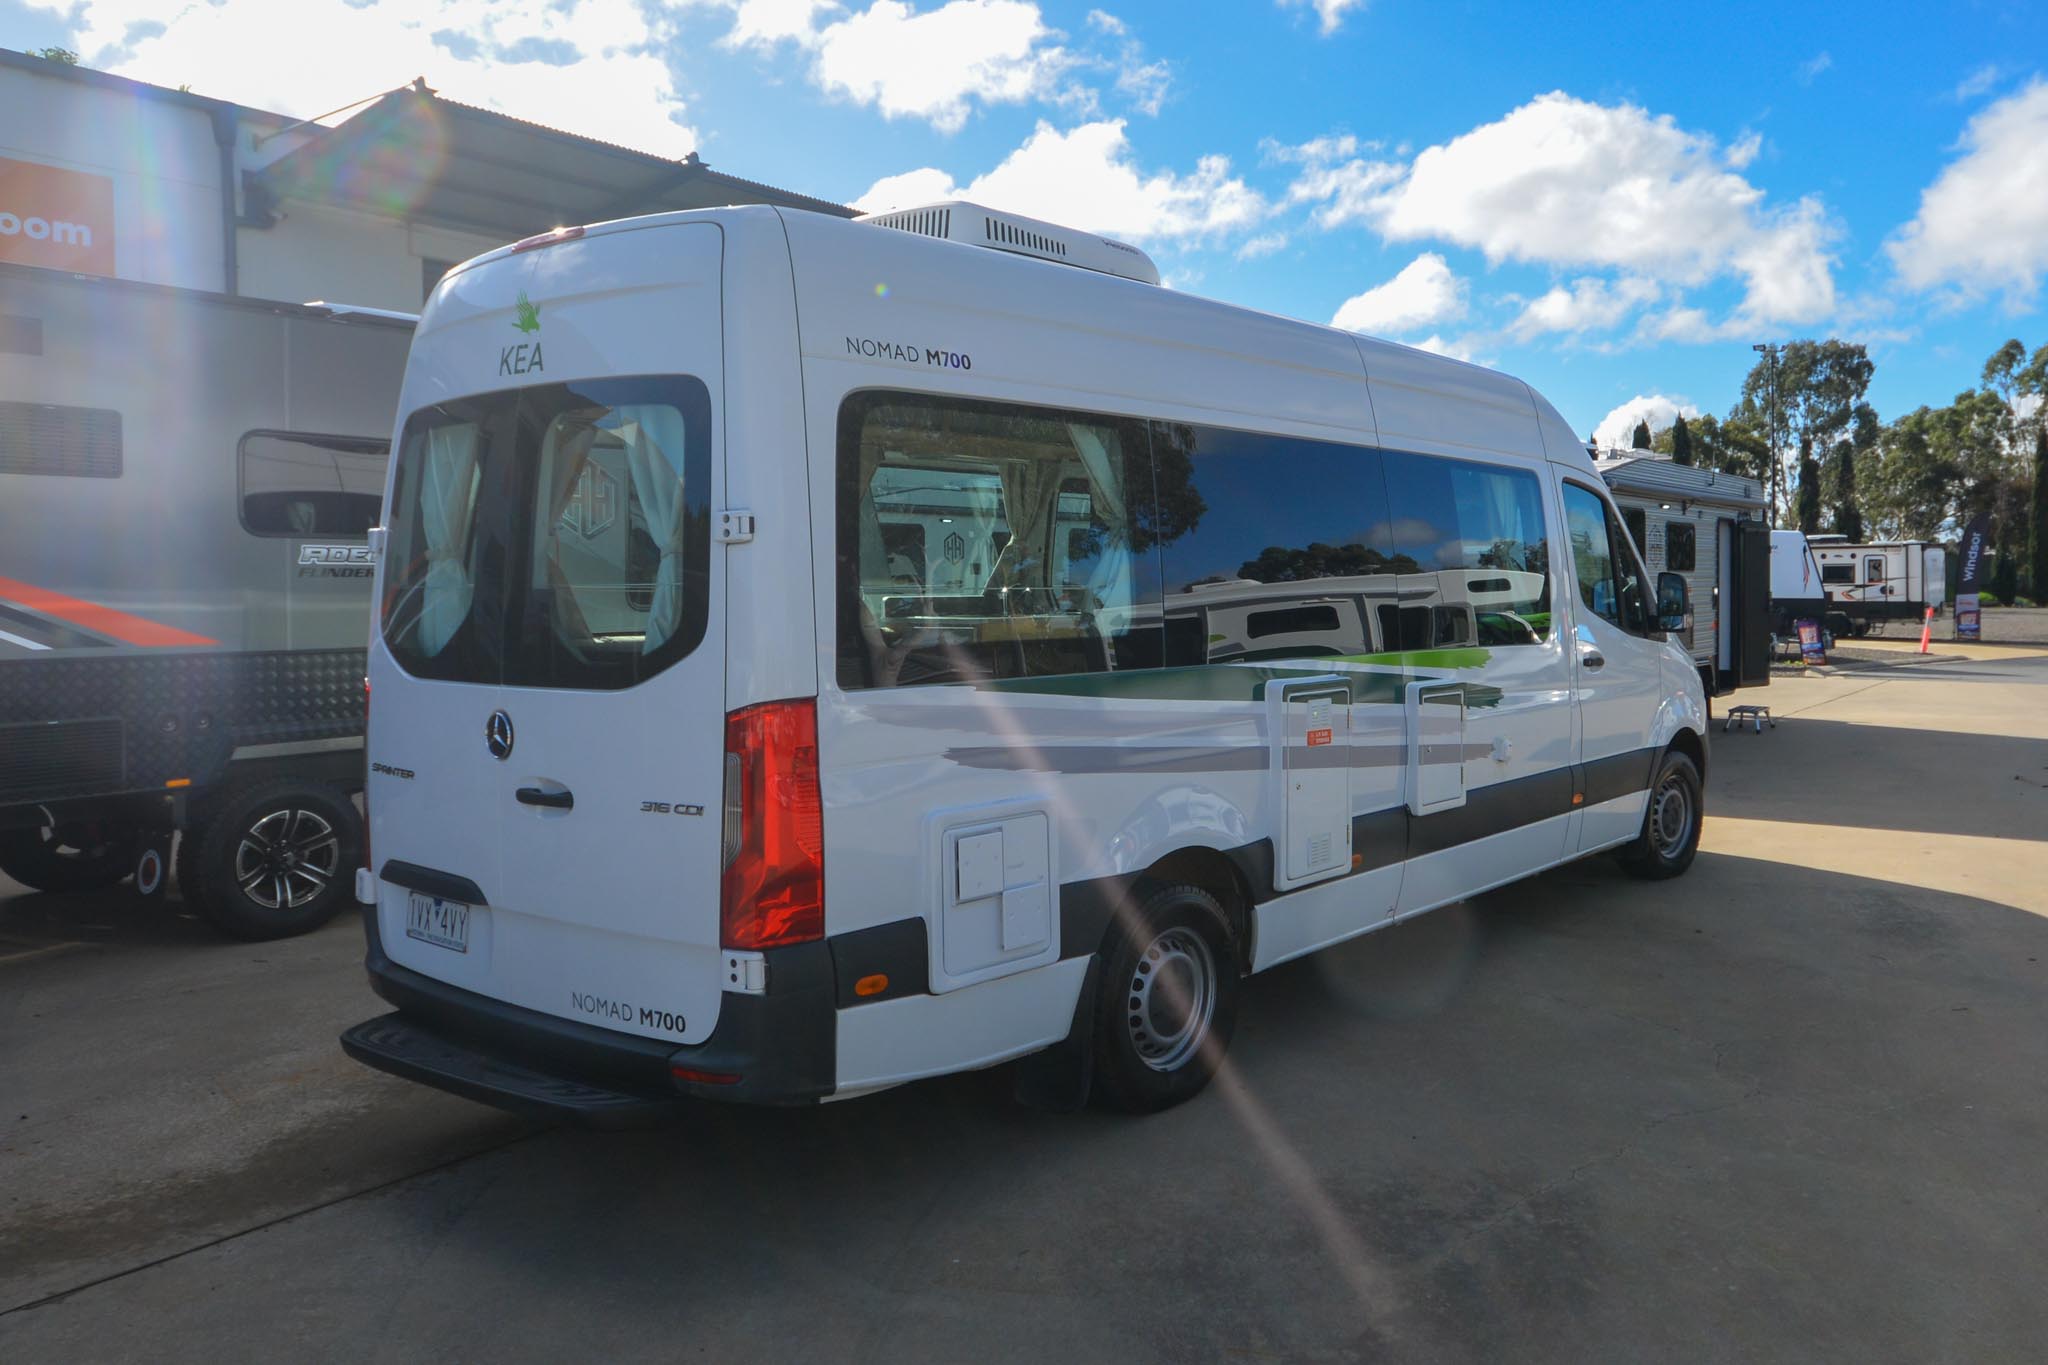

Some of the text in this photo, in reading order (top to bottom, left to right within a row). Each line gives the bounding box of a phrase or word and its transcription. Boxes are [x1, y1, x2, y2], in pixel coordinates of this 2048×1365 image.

[499, 342, 543, 376] KEA
[846, 336, 971, 370] NOMAD M700
[298, 544, 376, 565] ADE
[1963, 531, 1981, 581] Windsor
[299, 566, 375, 578] FLINDER
[371, 762, 415, 779] SPRINTER
[640, 800, 704, 816] 316 CDI
[572, 991, 686, 1033] NOMAD M700
